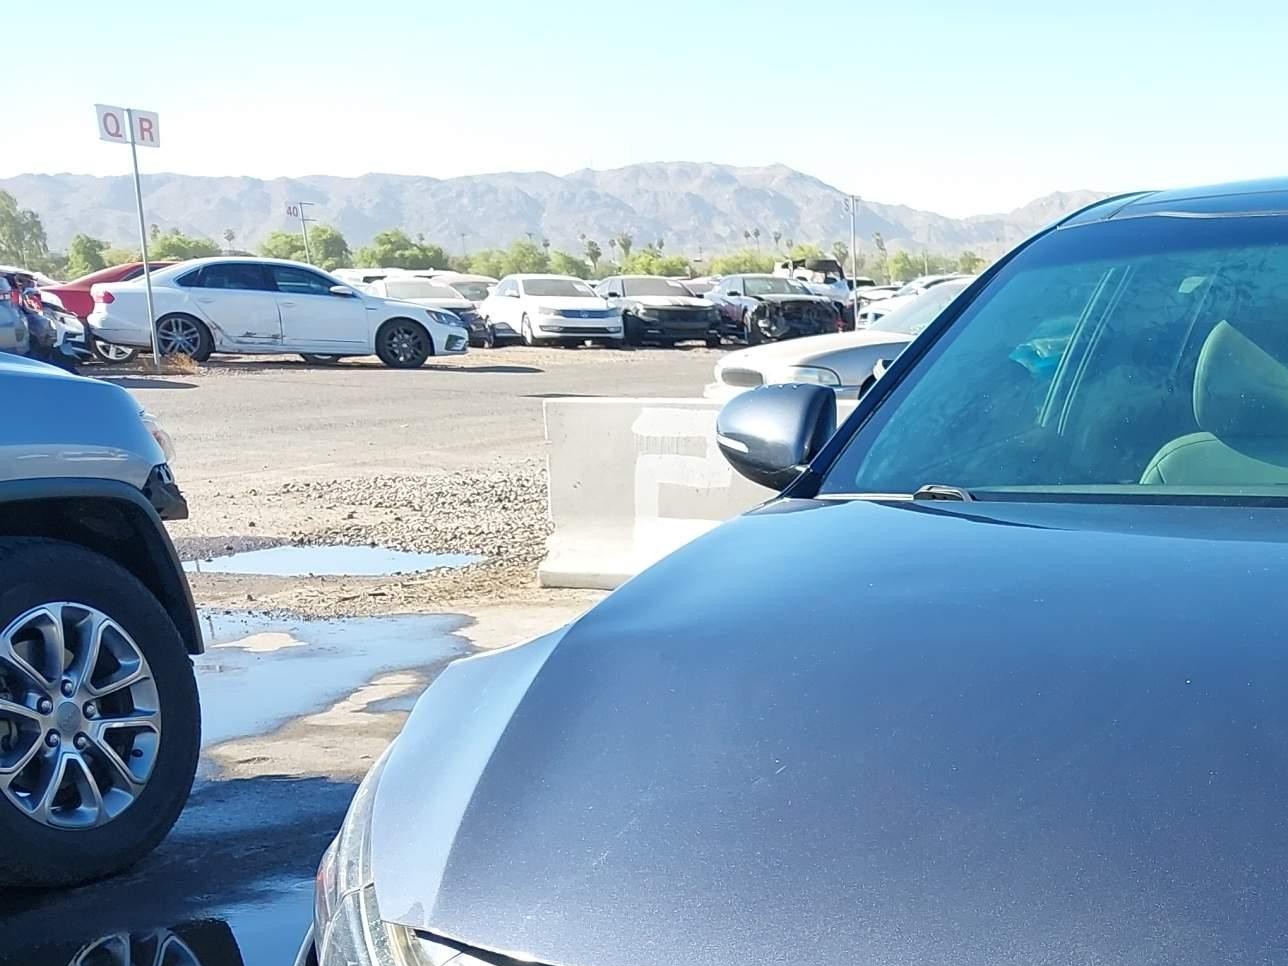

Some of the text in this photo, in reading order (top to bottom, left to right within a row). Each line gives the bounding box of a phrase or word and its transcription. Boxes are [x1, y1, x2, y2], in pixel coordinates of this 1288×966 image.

[102, 112, 123, 138] Q
[138, 117, 154, 142] R
[286, 205, 298, 217] 40
